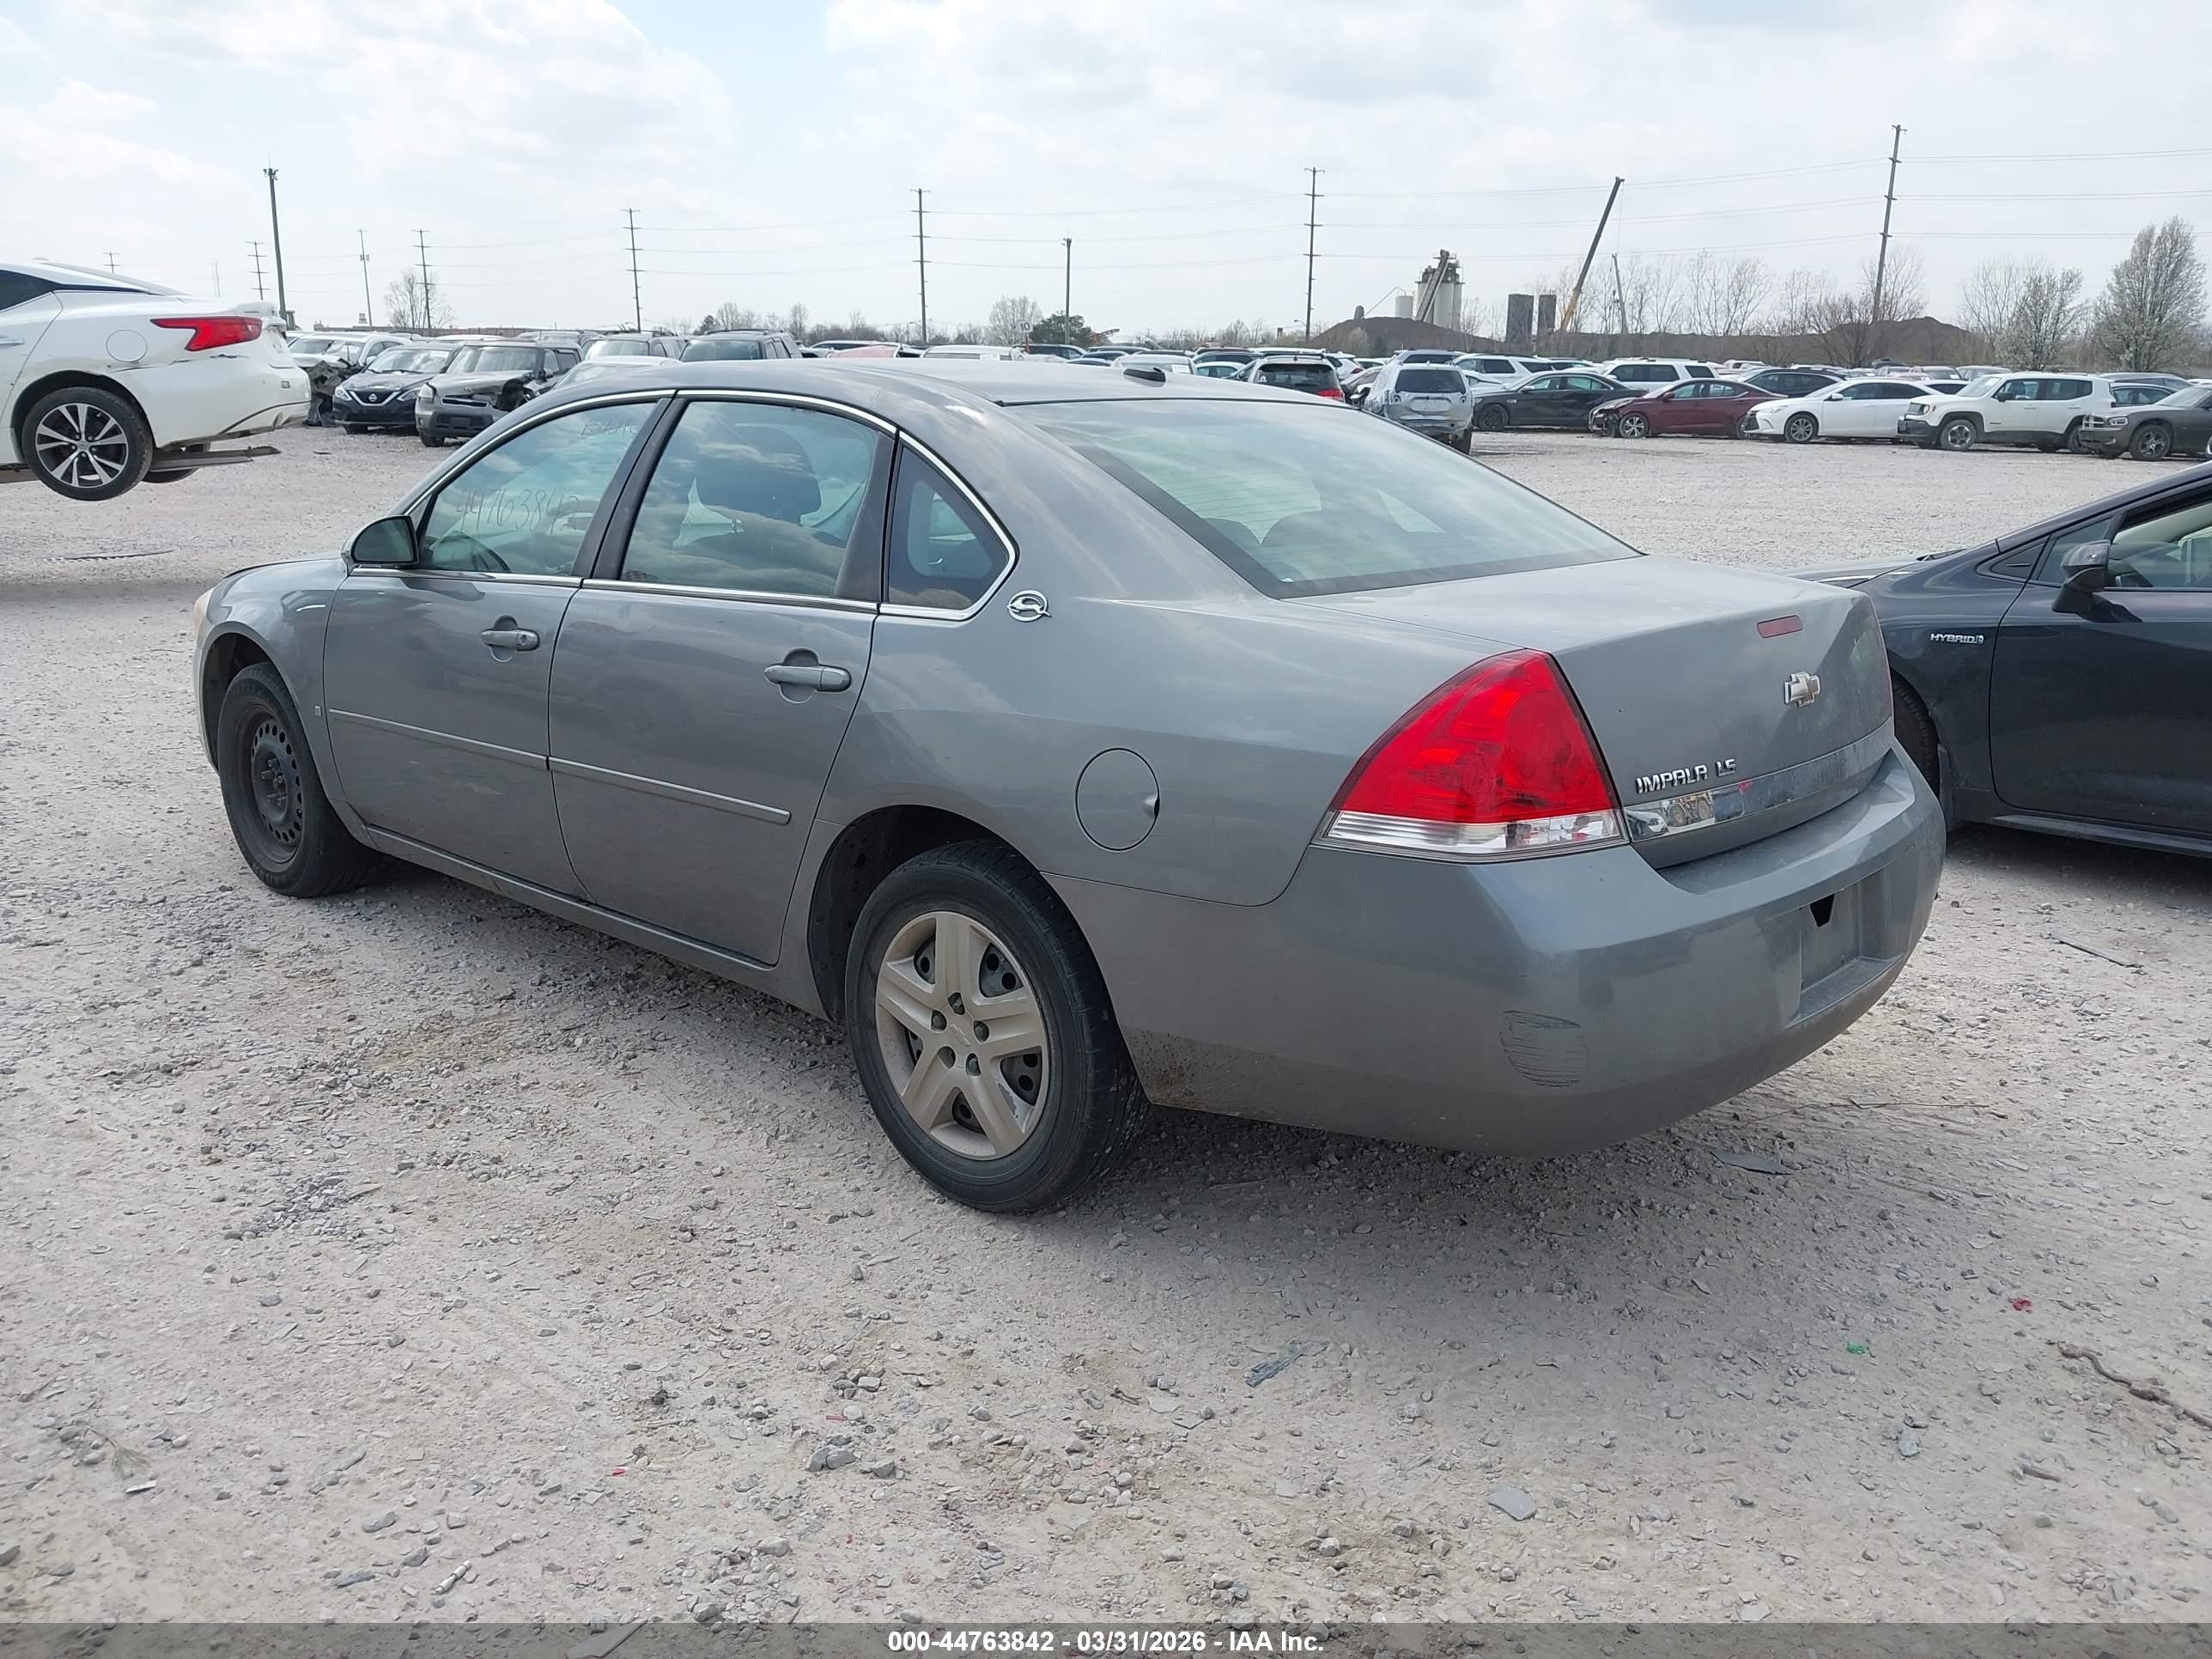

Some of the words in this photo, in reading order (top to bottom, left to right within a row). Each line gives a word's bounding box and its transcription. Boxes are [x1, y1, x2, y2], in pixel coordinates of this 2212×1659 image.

[1020, 322, 1030, 331] 10
[1929, 633, 1978, 644] HYBRID
[1635, 764, 1707, 794] IMPALA
[1715, 758, 1736, 777] LS
